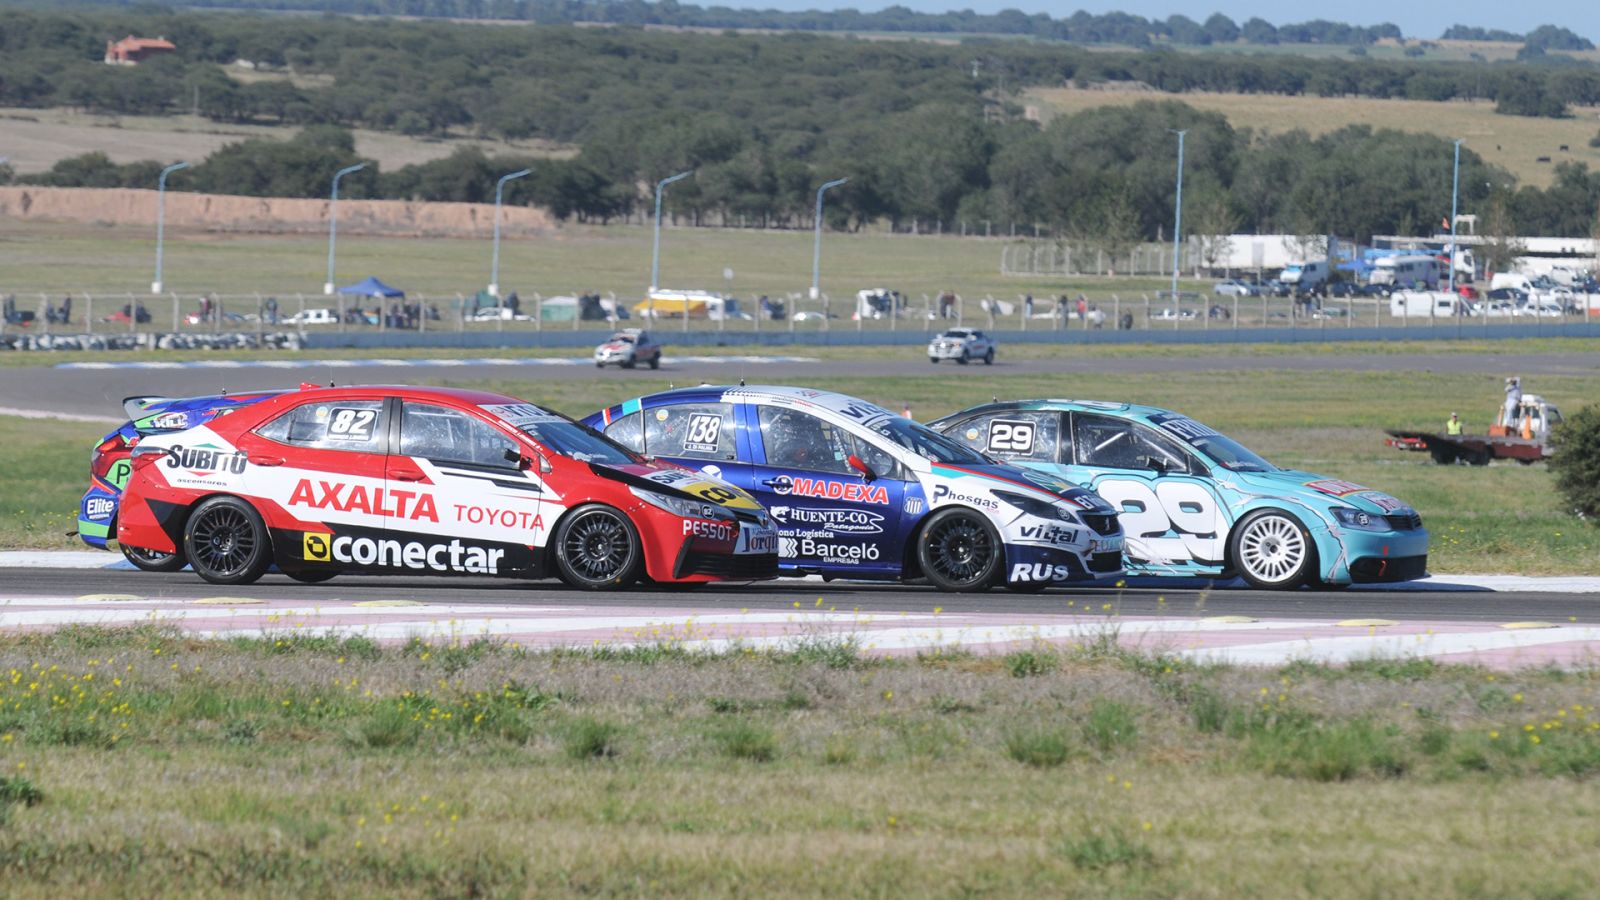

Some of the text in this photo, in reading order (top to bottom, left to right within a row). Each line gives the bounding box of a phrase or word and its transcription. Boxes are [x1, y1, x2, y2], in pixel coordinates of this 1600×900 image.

[331, 410, 375, 433] 82
[688, 416, 720, 443] 138
[991, 425, 1032, 450] 29
[167, 445, 249, 475] SUBITO
[288, 479, 440, 523] AXALTA
[792, 478, 889, 504] MADEXA
[933, 484, 1000, 511] Phosgas
[87, 498, 114, 515] Elite
[454, 504, 545, 531] TOYOTA
[791, 508, 868, 524] HUENTE-CO
[683, 520, 732, 541] PESSOT
[824, 522, 875, 531] Patagonia
[1098, 480, 1230, 561] 29
[796, 529, 834, 539] Logística
[332, 536, 504, 574] conectar
[801, 540, 880, 560] Barceló
[824, 557, 860, 565] EMPRESAS
[1010, 563, 1069, 583] RUS
